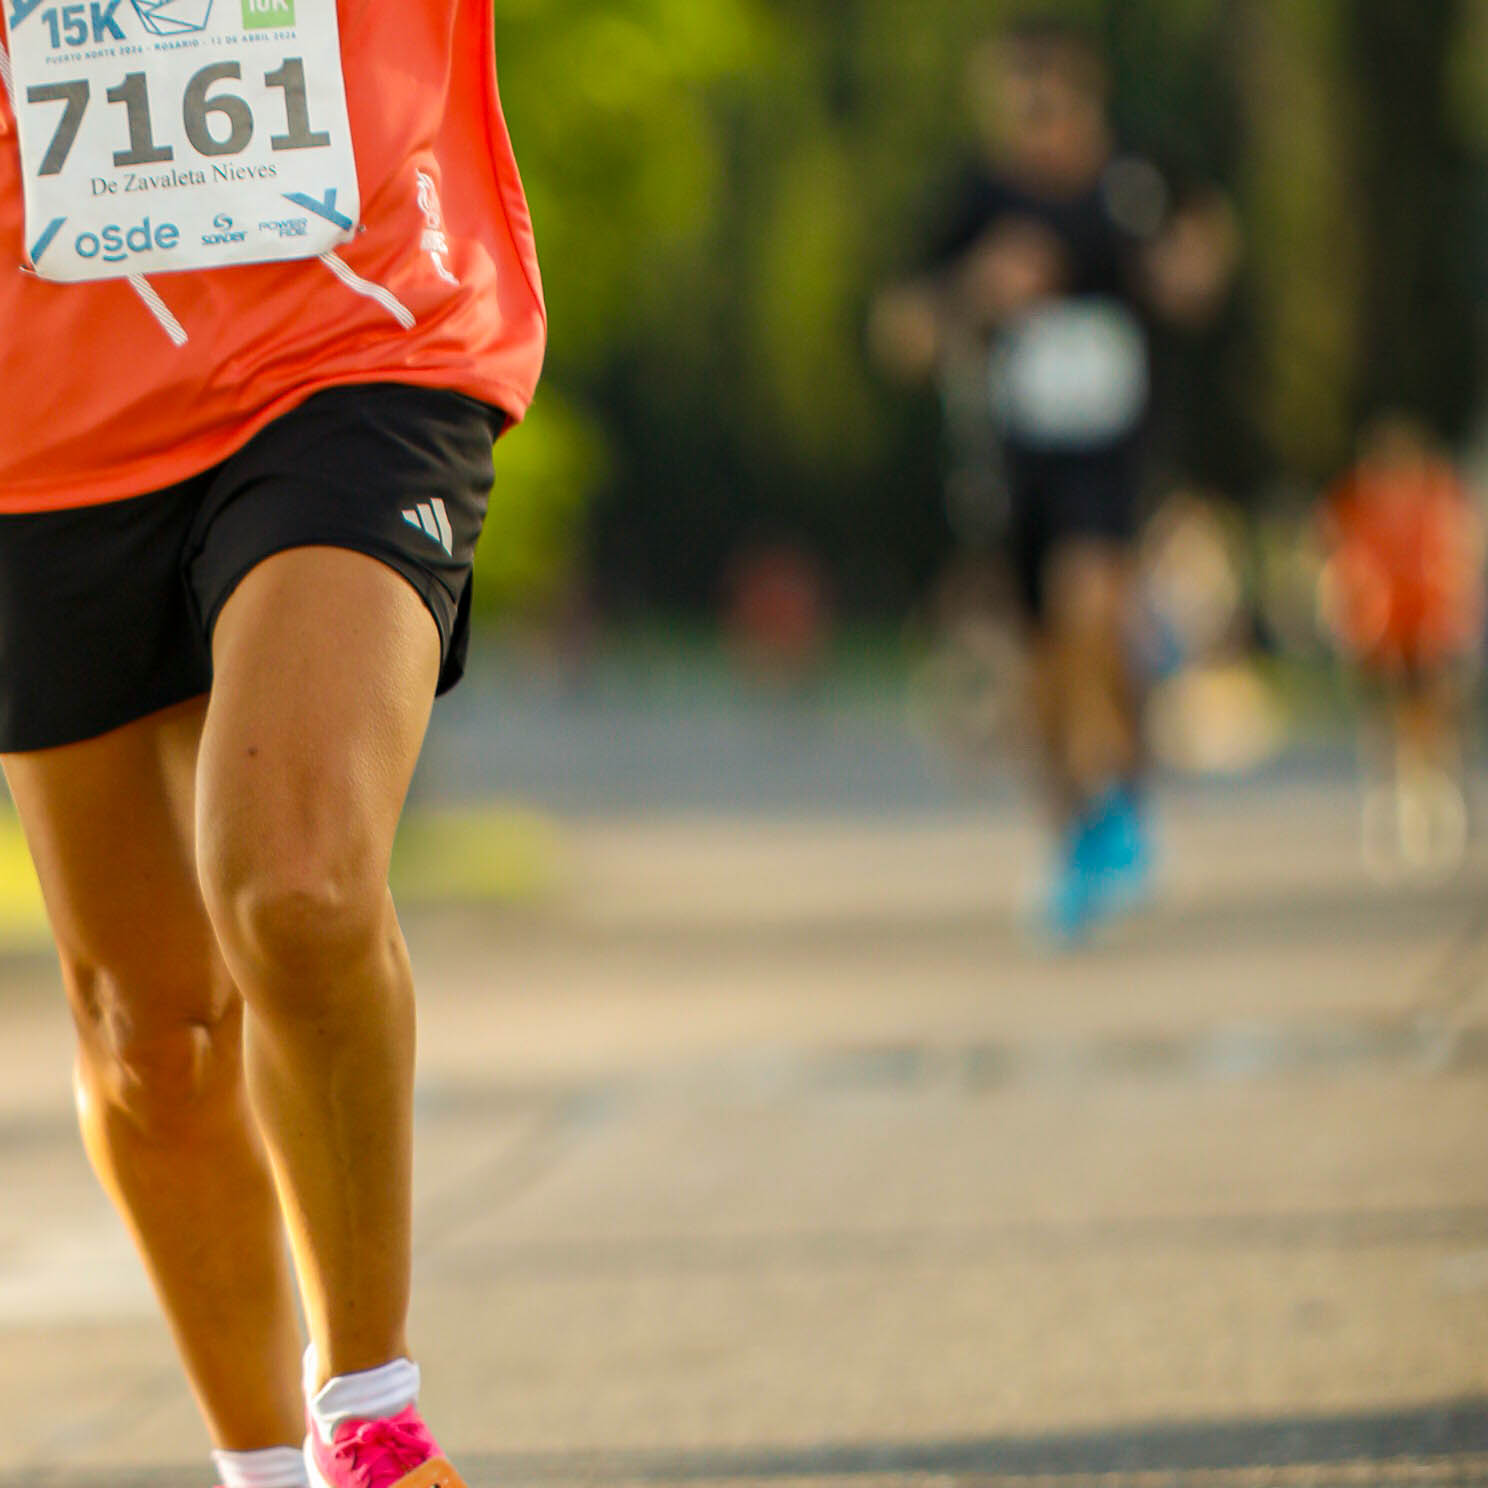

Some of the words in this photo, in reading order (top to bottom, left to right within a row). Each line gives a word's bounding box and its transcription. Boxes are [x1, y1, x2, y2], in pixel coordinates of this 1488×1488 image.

[41, 0, 125, 49] 15K
[85, 48, 116, 59] NORTE
[154, 38, 200, 51] ROSARIO
[226, 35, 238, 46] DE
[242, 32, 270, 43] ABRIL
[27, 57, 330, 177] 7161
[91, 176, 118, 196] De
[124, 168, 206, 192] Zavaleta
[211, 162, 278, 183] Nieves
[74, 216, 179, 259] osde
